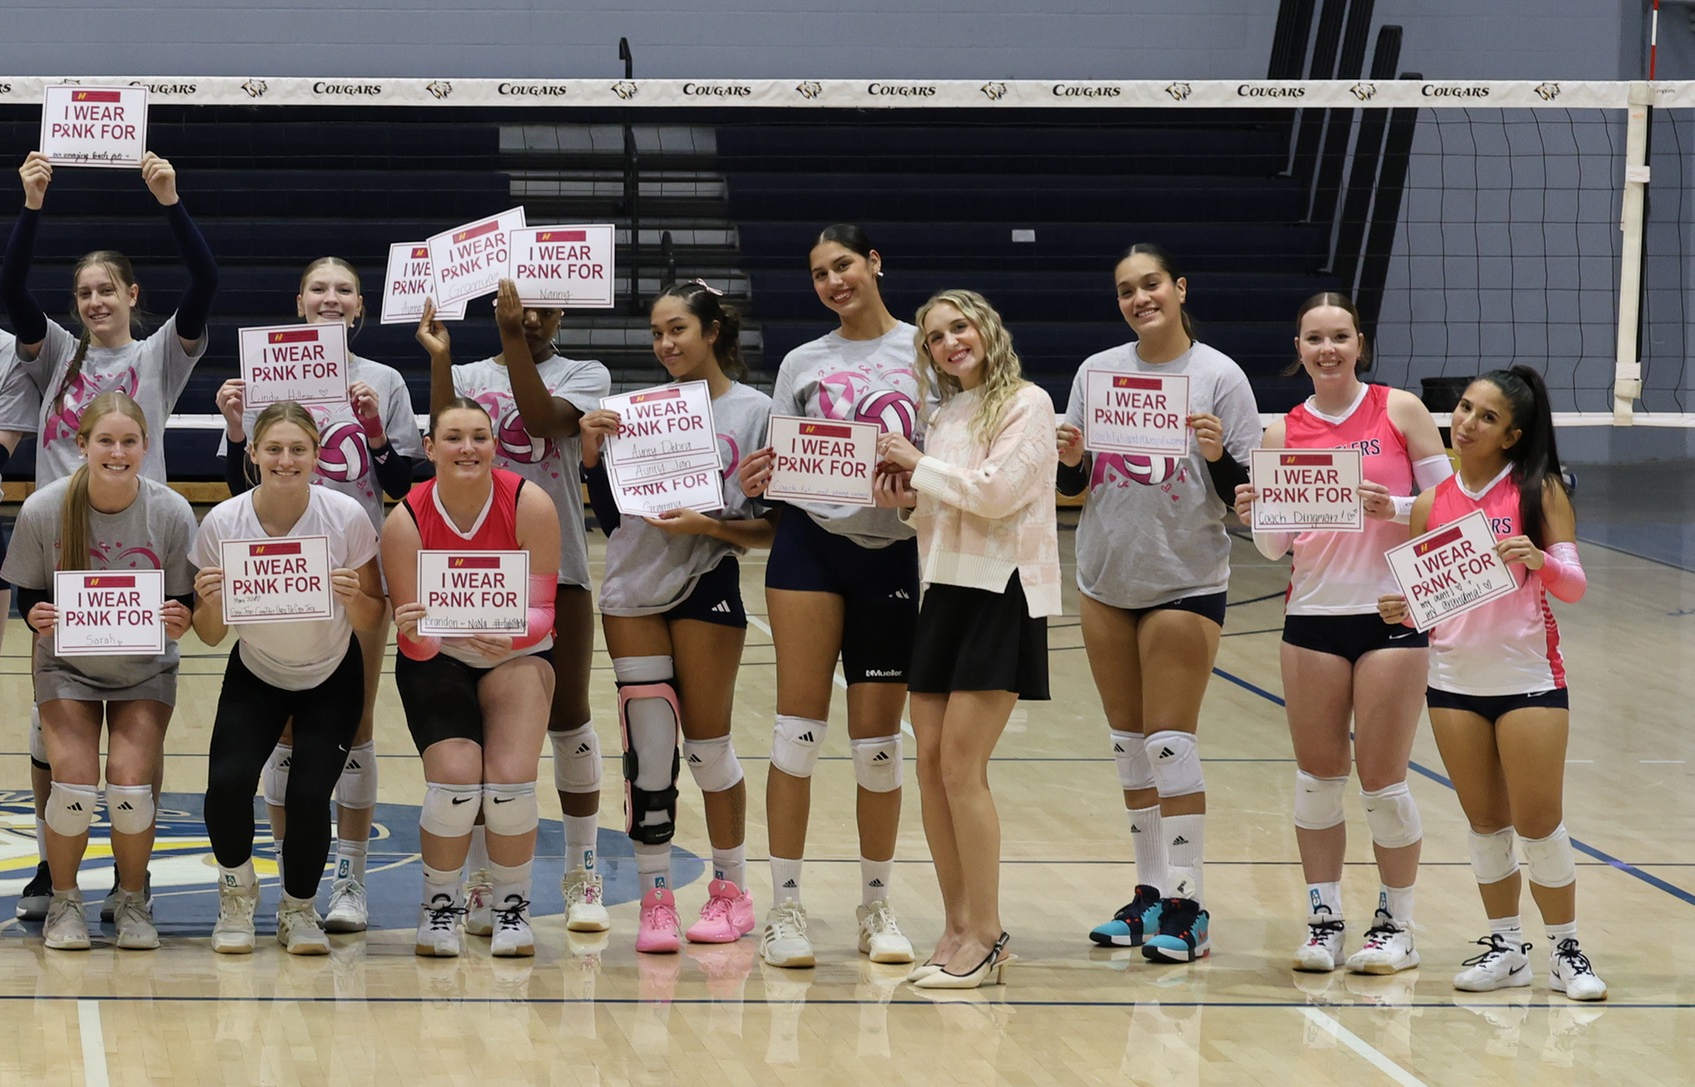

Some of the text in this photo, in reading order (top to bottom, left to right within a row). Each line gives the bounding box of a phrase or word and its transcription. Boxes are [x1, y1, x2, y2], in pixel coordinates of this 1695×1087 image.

[74, 105, 124, 121] WEAR
[101, 124, 135, 140] FOR
[63, 152, 89, 164] amazing
[456, 232, 505, 259] WEAR
[539, 245, 591, 261] WEAR
[485, 248, 506, 267] FO
[403, 262, 408, 277] I
[568, 263, 603, 279] FOR
[539, 288, 570, 305] Nanny
[272, 345, 325, 363] WEAR
[302, 362, 338, 379] FOR
[1115, 391, 1166, 410] WEAR
[634, 400, 688, 420] WEAR
[666, 415, 703, 432] FOR
[1143, 412, 1178, 429] FOR
[660, 439, 692, 455] Debra
[801, 439, 855, 458] WEAR
[671, 459, 692, 470] Jan
[830, 460, 867, 479] FOR
[671, 472, 708, 489] FOR
[1284, 469, 1339, 485] WEAR
[1315, 487, 1353, 503] FOR
[1259, 509, 1345, 528] Coach Dingman!
[253, 558, 308, 576] WEAR
[1414, 540, 1476, 578] I WEAR
[1457, 553, 1496, 580] FOR
[284, 576, 321, 593] FOR
[451, 572, 505, 588] WEAR
[87, 591, 141, 607] WEAR
[481, 591, 517, 608] FOR
[1419, 600, 1432, 609] my
[117, 610, 153, 626] FOR
[425, 616, 458, 628] Brandon
[1424, 608, 1438, 620] my
[86, 633, 116, 645] Sarah
